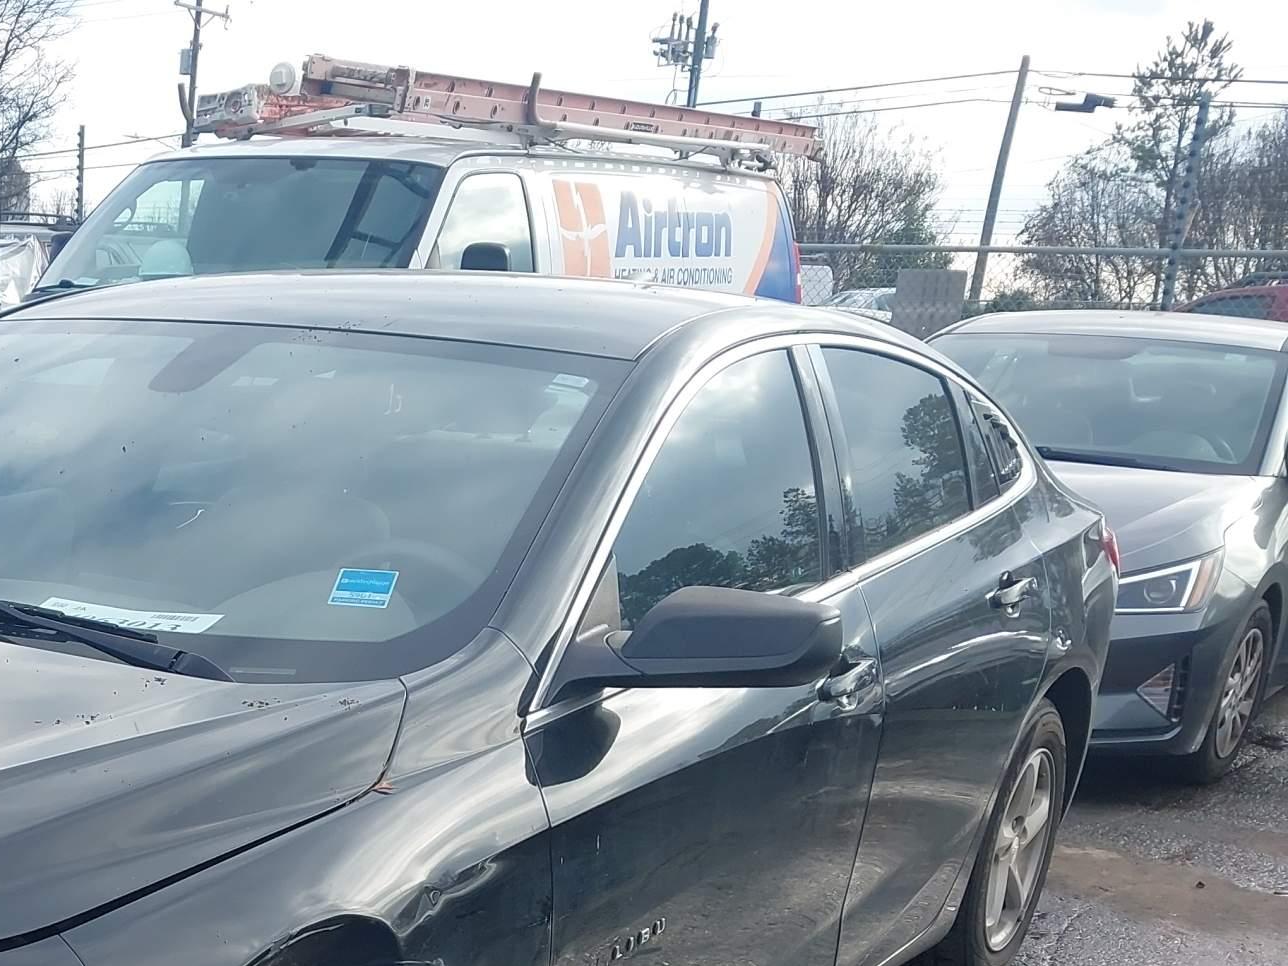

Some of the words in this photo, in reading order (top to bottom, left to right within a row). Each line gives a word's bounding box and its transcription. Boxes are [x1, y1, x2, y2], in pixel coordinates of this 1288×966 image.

[615, 191, 732, 258] Airtron
[653, 267, 659, 283] &
[661, 267, 675, 285] AIR
[676, 267, 733, 286] CONDITIONING
